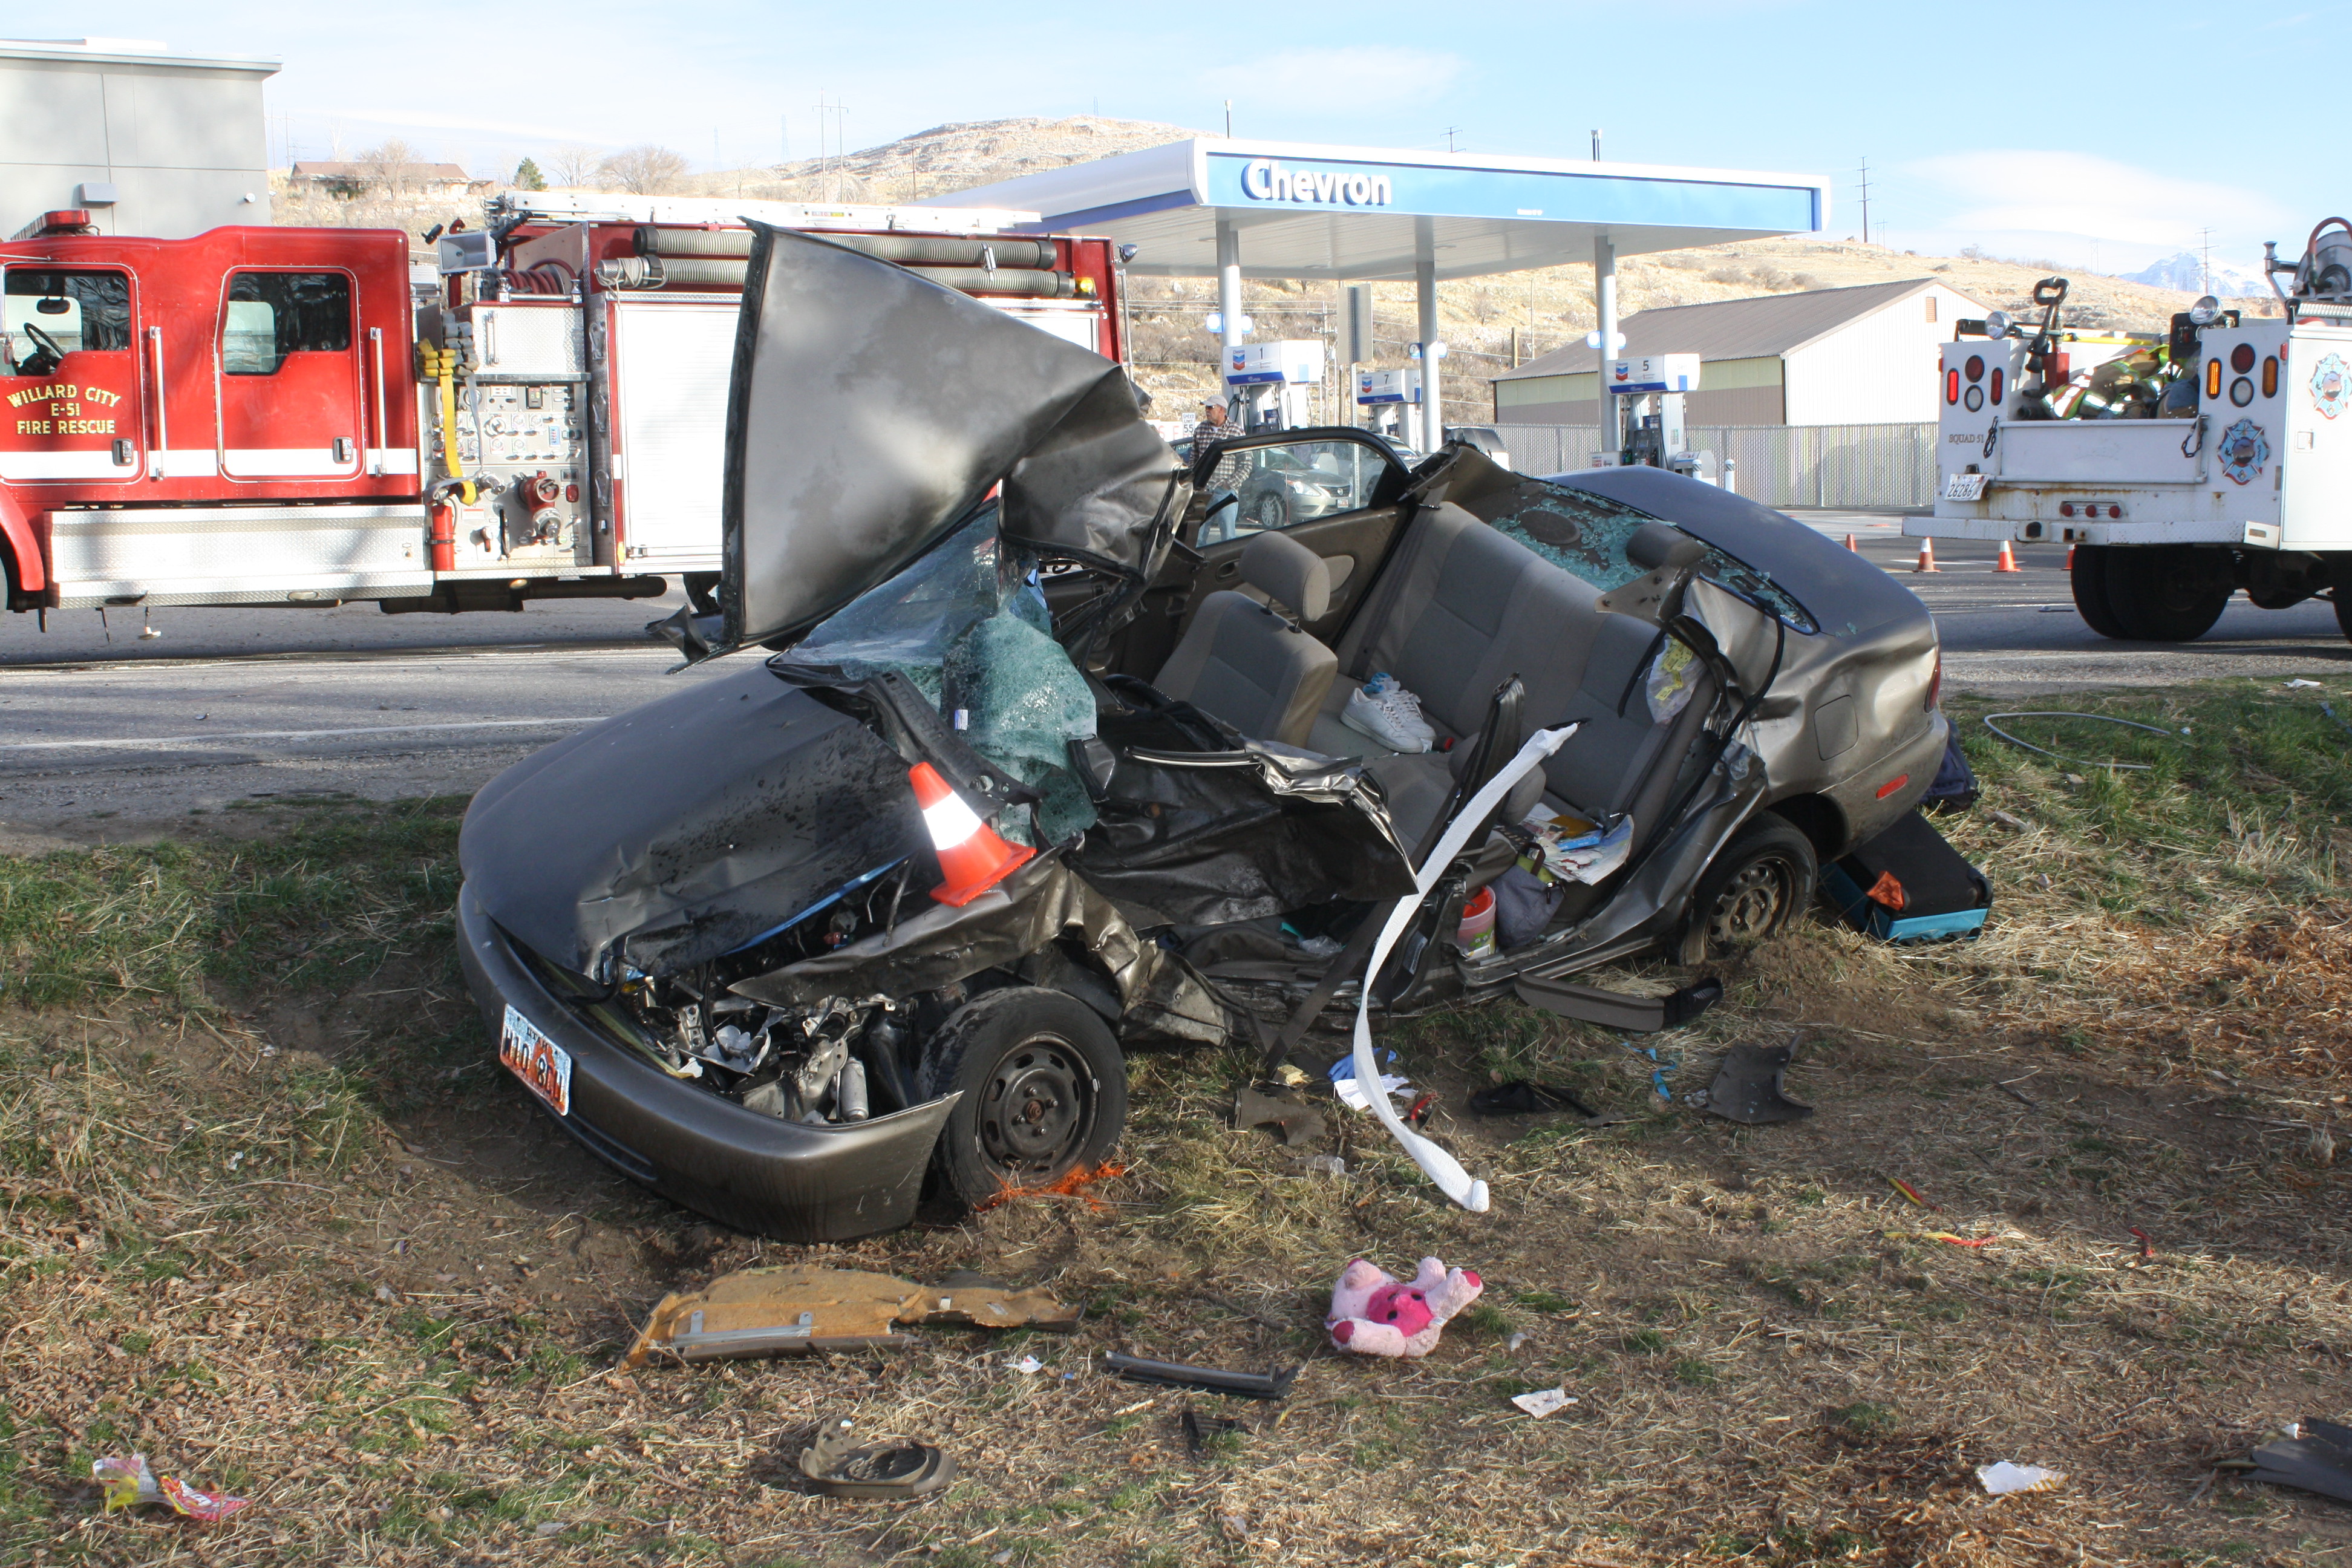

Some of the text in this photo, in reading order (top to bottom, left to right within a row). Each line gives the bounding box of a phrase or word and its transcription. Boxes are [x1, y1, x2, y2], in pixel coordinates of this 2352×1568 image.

[1241, 158, 1391, 205] Chevron
[1259, 347, 1263, 359] 1
[1643, 360, 1649, 371] 5
[1384, 374, 1389, 384] 7
[6, 384, 121, 408] WILLARD CITY
[51, 403, 80, 416] E-51
[16, 420, 116, 434] FIRE RESCUE
[1184, 424, 1194, 433] 55
[1949, 434, 1984, 445] SQUAD 51
[1947, 484, 1975, 497] 26286
[526, 1027, 548, 1050] UTAH
